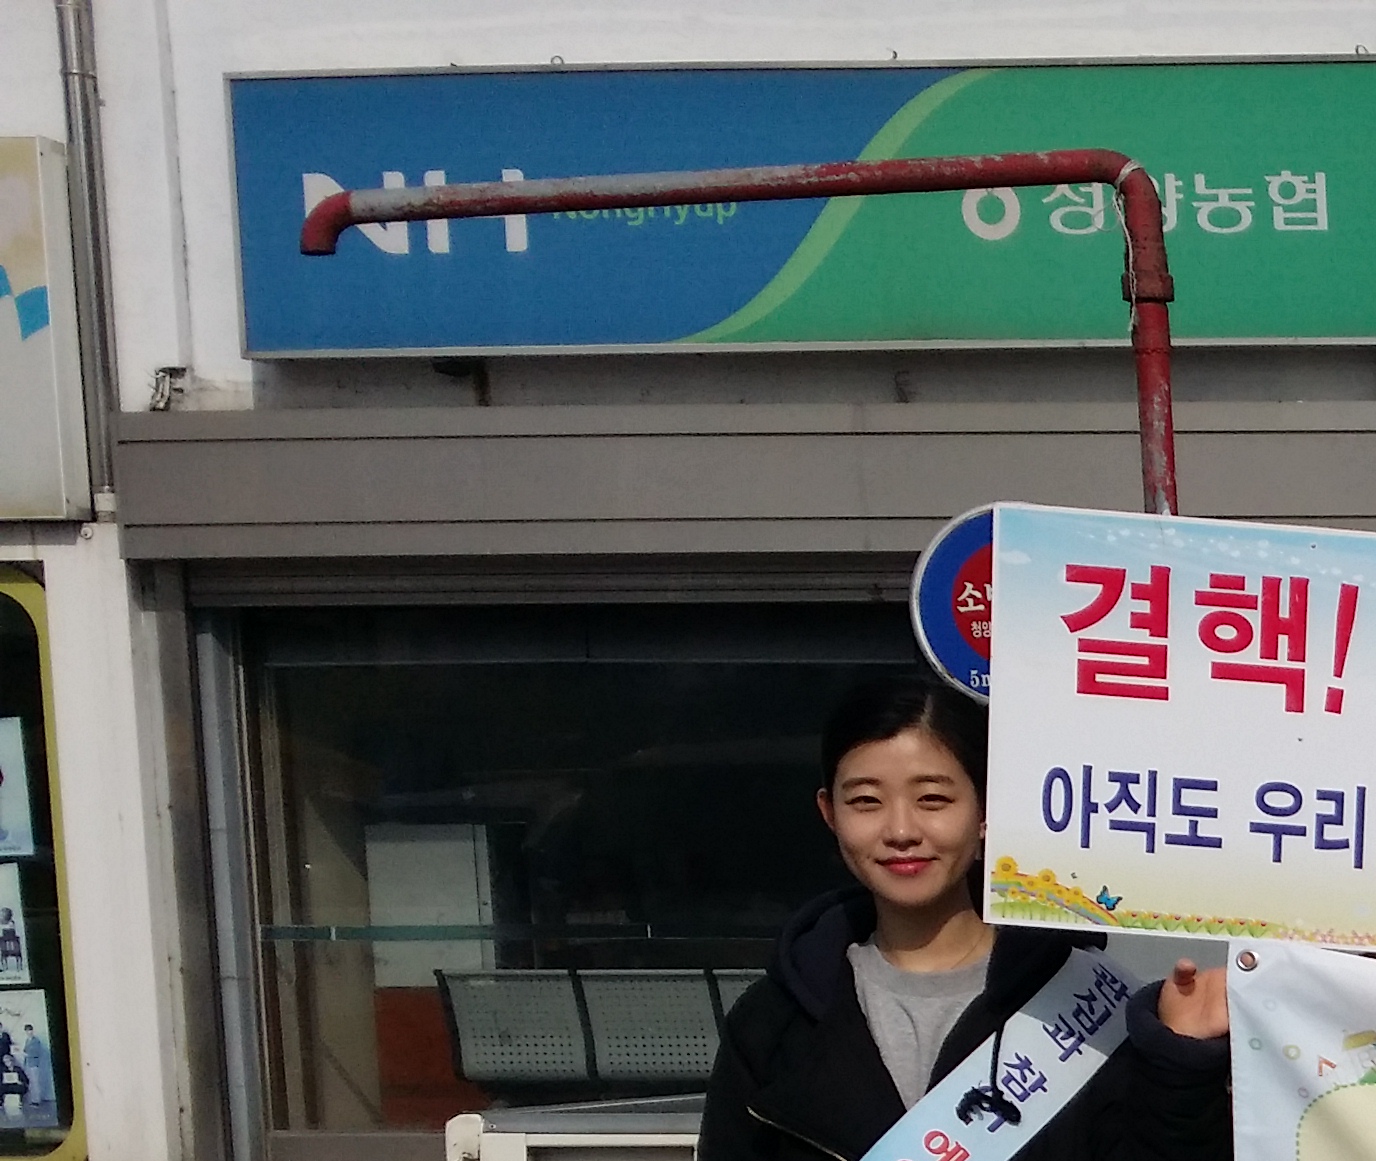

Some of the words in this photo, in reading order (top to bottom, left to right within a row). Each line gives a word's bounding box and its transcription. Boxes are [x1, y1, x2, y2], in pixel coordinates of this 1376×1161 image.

[956, 582, 993, 613] 소
[1060, 562, 1360, 717] 결핵!
[1041, 763, 1223, 854] 아직도
[1248, 779, 1368, 871] 우리
[1042, 962, 1131, 1063] 관심과
